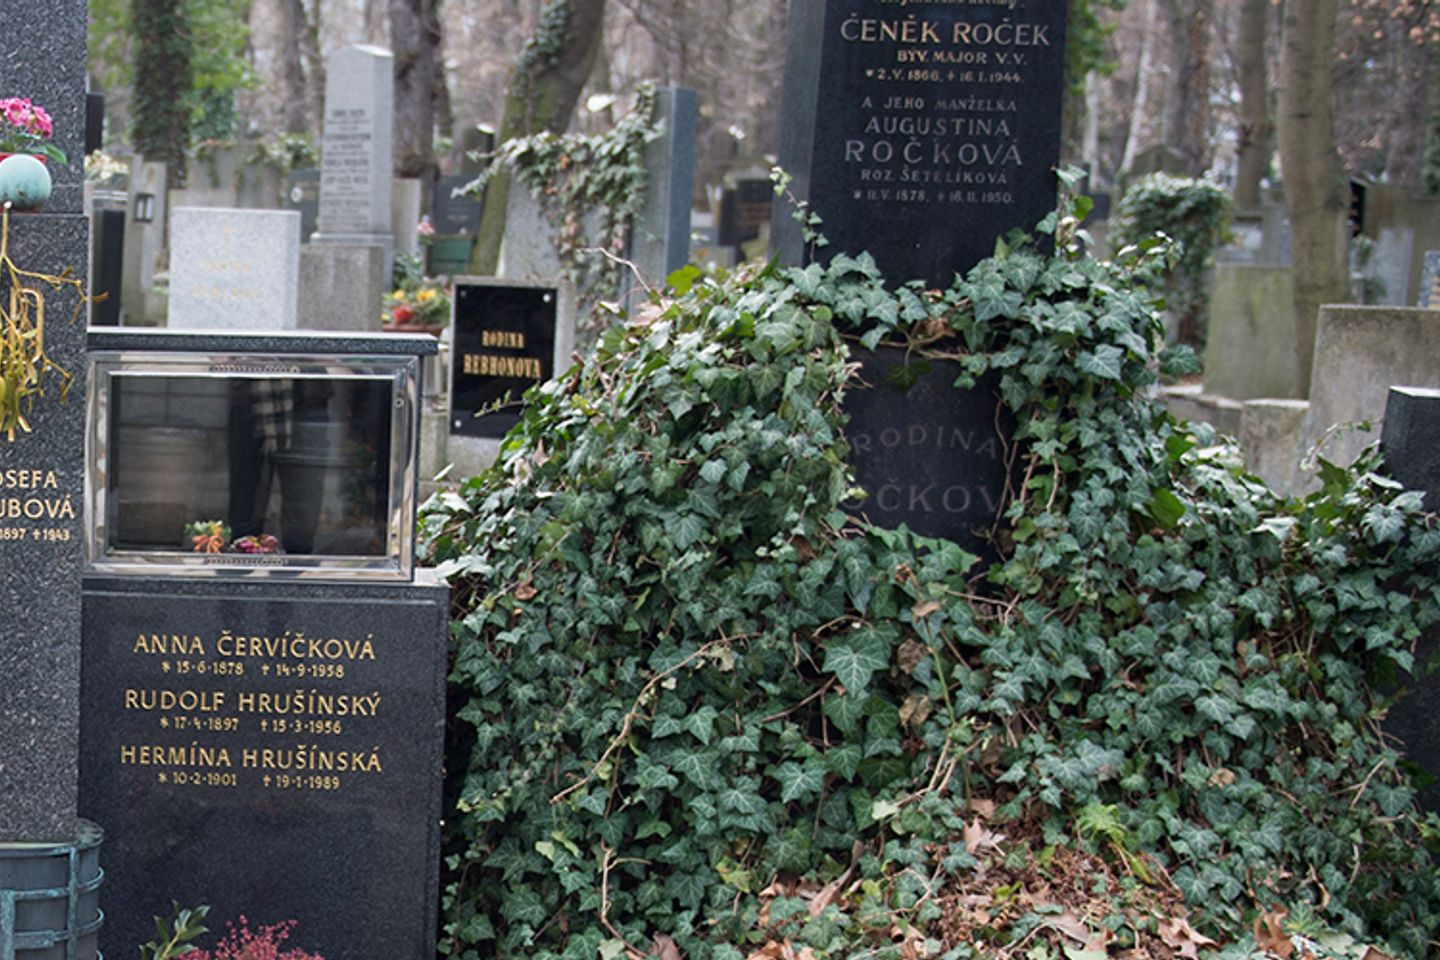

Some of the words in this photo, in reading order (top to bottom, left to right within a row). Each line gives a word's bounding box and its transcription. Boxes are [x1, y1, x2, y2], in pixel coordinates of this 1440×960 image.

[840, 12, 941, 43] ČENĚK
[952, 18, 1051, 46] ROČEK
[932, 50, 987, 64] MAJOR
[861, 97, 873, 109] A
[883, 97, 925, 109] JEHO
[934, 94, 1017, 112] MANŽELKA
[864, 116, 1011, 136] AUGUSTINA
[844, 136, 1024, 166] ROČKOVÁ
[481, 330, 525, 348] RODINA
[851, 424, 998, 460] RODINA
[133, 634, 205, 655] ANNA
[216, 630, 376, 660] ČERVÍČKOVÁ
[124, 689, 225, 712] RUDOLF
[238, 688, 382, 716] HRUŠÍNSKÝ
[120, 741, 232, 767] HERMÍNA
[242, 744, 383, 772] HRUŠÍNSKÁ
